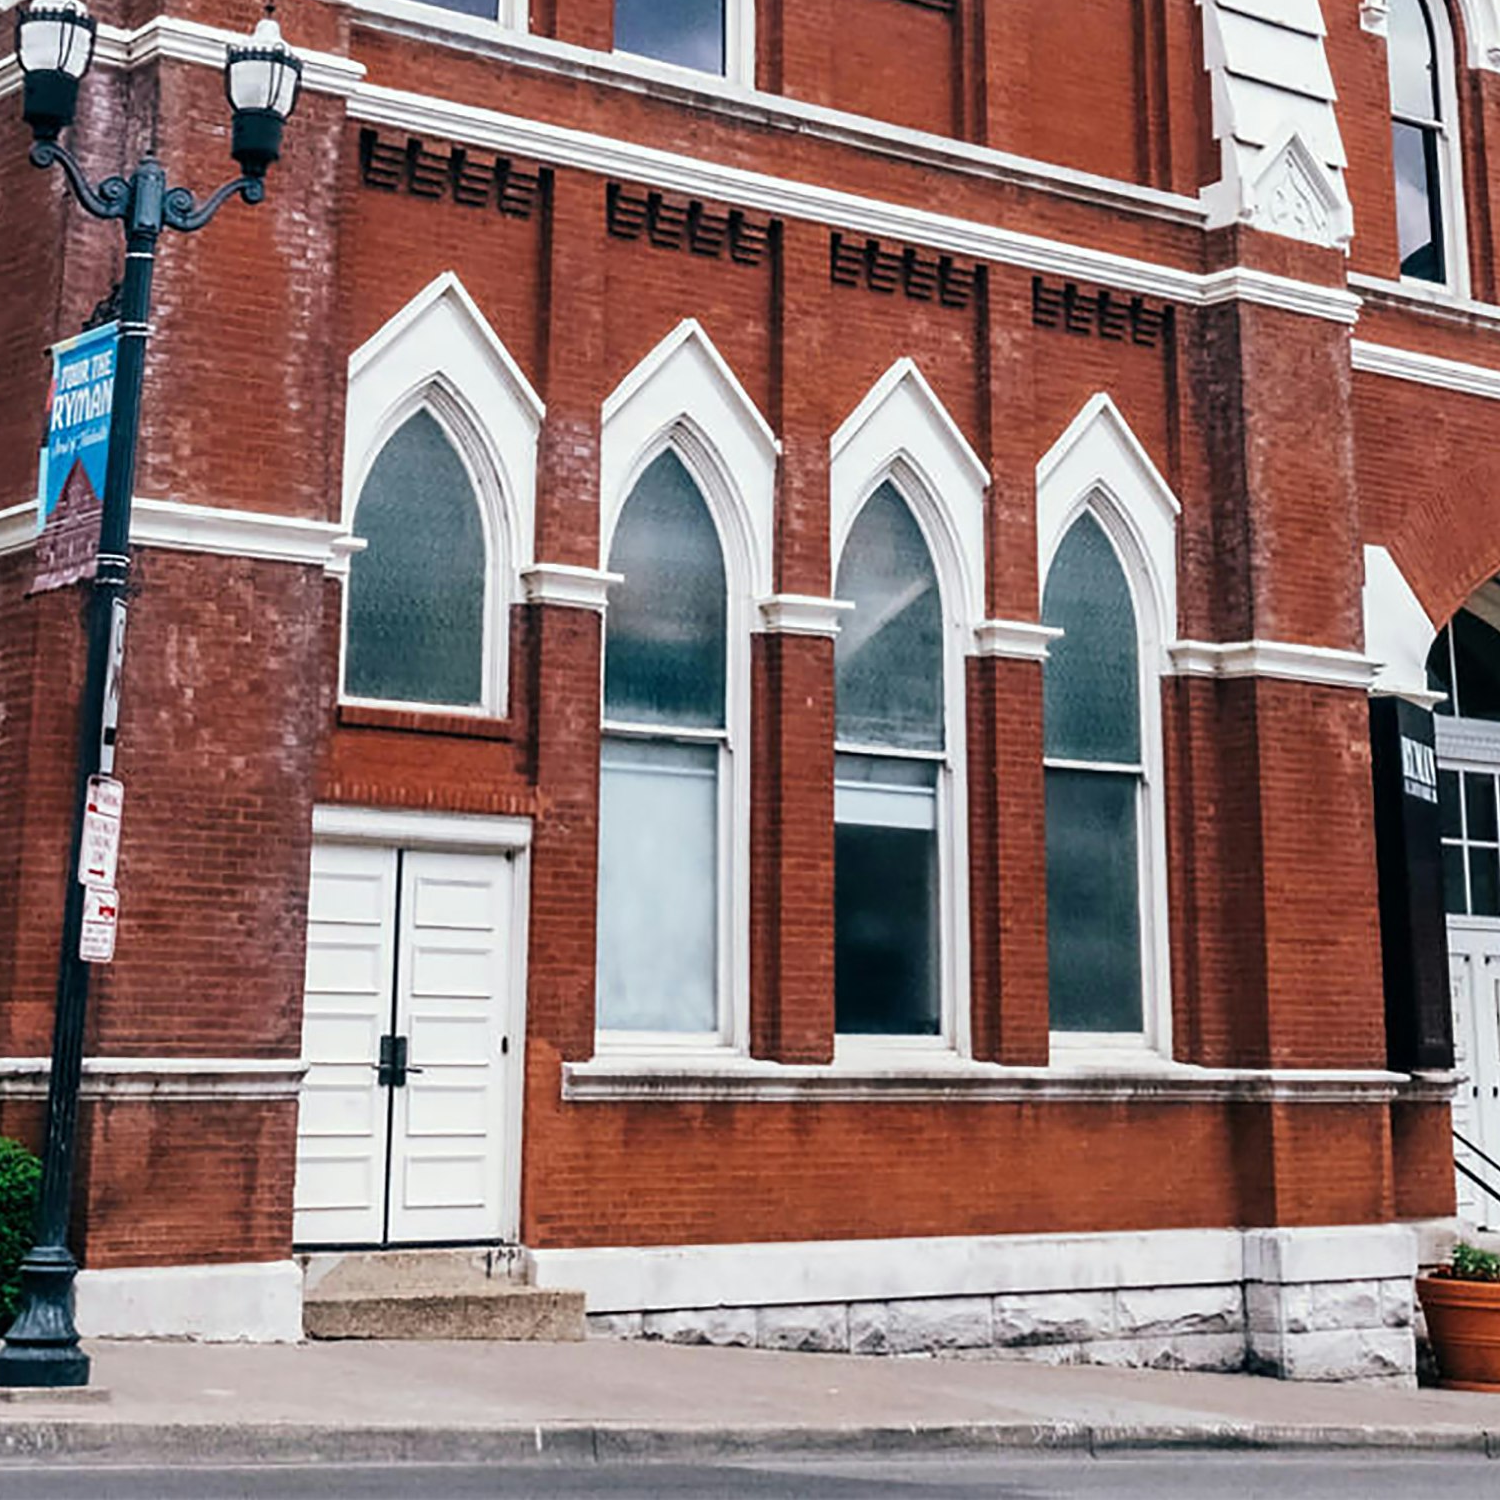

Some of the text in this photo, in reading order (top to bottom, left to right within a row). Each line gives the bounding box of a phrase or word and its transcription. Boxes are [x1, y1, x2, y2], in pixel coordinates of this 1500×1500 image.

[61, 350, 114, 391] TOUR THE
[51, 377, 115, 432] RYMAN
